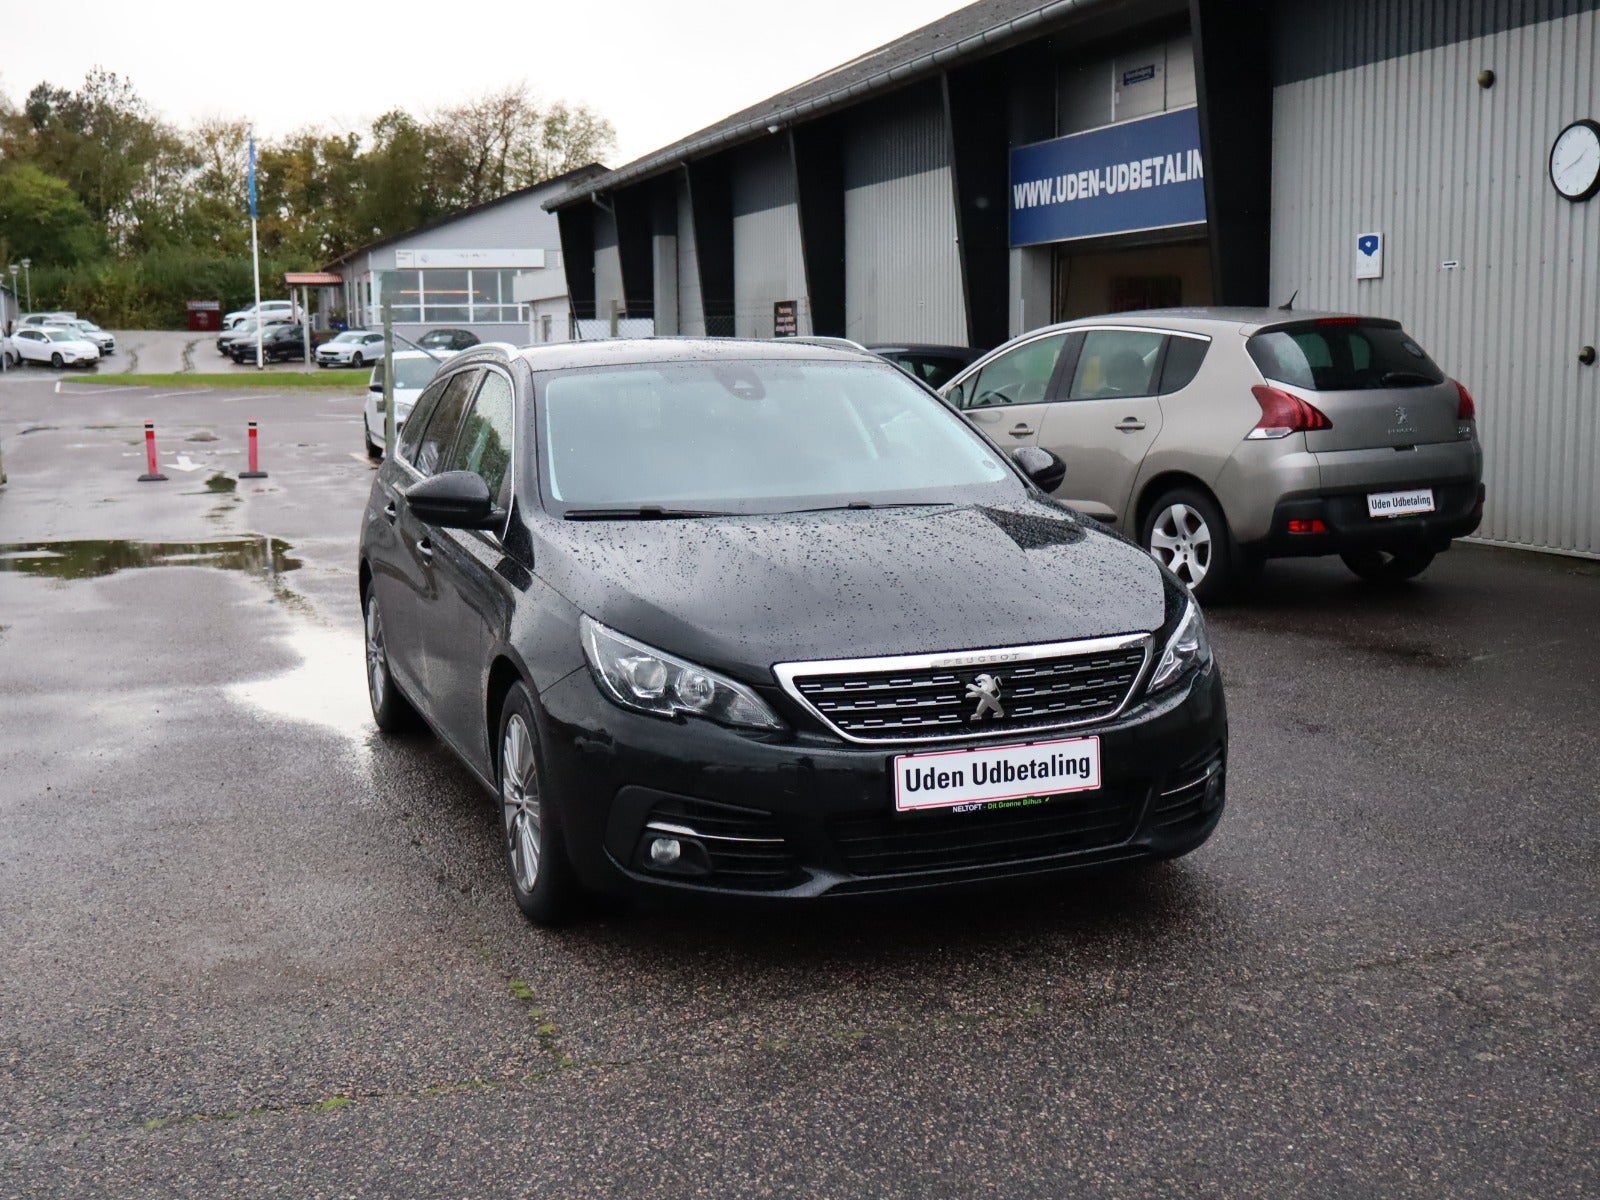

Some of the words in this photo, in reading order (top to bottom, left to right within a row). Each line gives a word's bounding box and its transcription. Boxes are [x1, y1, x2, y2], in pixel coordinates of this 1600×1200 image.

[1371, 499, 1391, 509] Uden
[1392, 495, 1431, 507] Udbetaling
[943, 653, 1020, 666] PEUGEOT
[905, 767, 964, 792] Uden
[972, 753, 1091, 784] Udbetaling
[952, 803, 982, 813] NELTOFT
[1022, 798, 1042, 806] Bilhus
